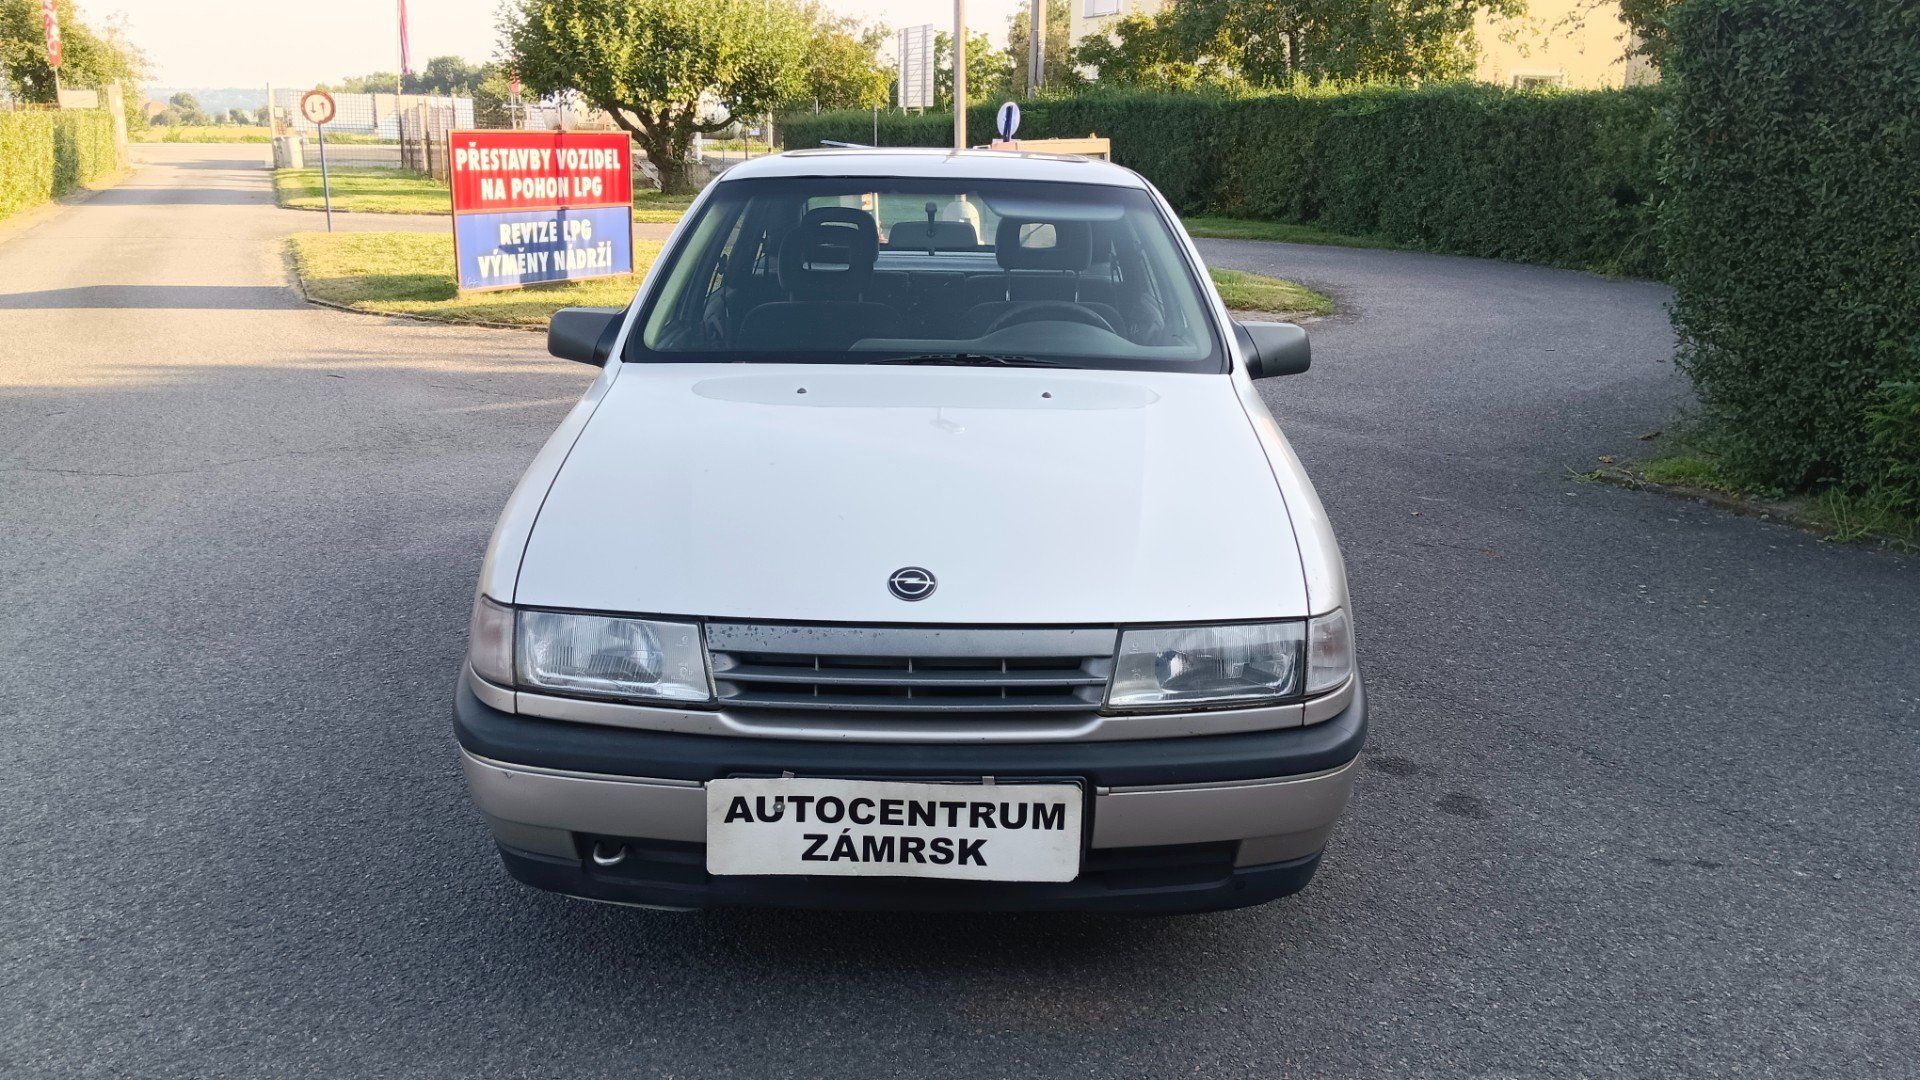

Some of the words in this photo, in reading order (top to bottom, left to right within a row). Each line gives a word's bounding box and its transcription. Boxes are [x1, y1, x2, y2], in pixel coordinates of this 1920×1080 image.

[455, 142, 551, 171] PŘESTAVBY
[555, 148, 620, 170] VOZIDEL
[481, 178, 506, 201] NA
[511, 177, 569, 200] POHON
[574, 176, 603, 197] LPG
[499, 221, 558, 245] REVIZE
[563, 218, 592, 241] LPG
[478, 247, 549, 278] VÝMĚNY
[554, 241, 612, 271] NÁDRŽÍ
[724, 795, 1065, 831] AUTOCENTRUM
[801, 828, 988, 866] ZÁMRSK
